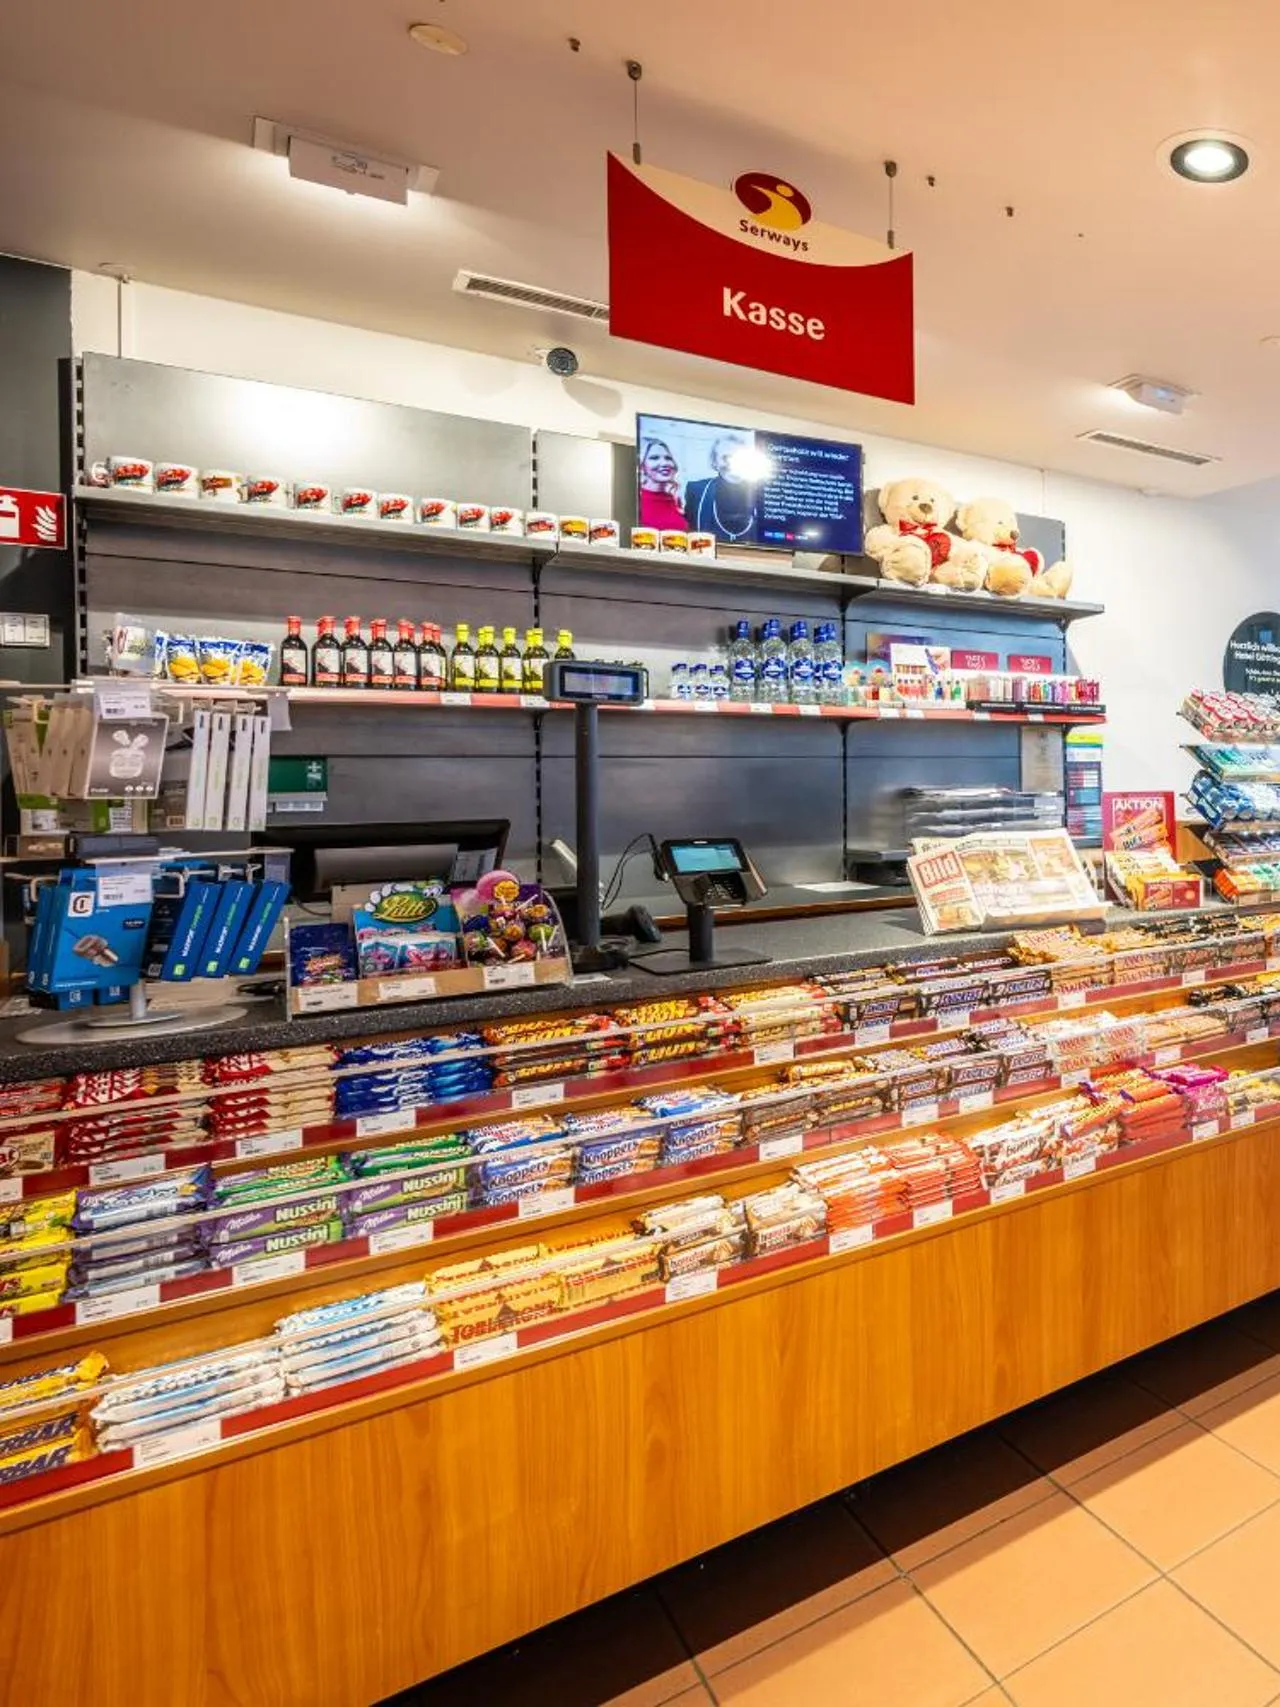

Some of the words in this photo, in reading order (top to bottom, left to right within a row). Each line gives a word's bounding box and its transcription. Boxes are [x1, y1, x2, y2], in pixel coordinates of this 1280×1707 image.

[738, 219, 810, 252] Serways
[723, 286, 826, 341] Kasse
[1115, 798, 1163, 811] AKTION
[380, 895, 428, 919] Lutti
[583, 1139, 640, 1165] Knoppers
[488, 1160, 550, 1189] Knoppers
